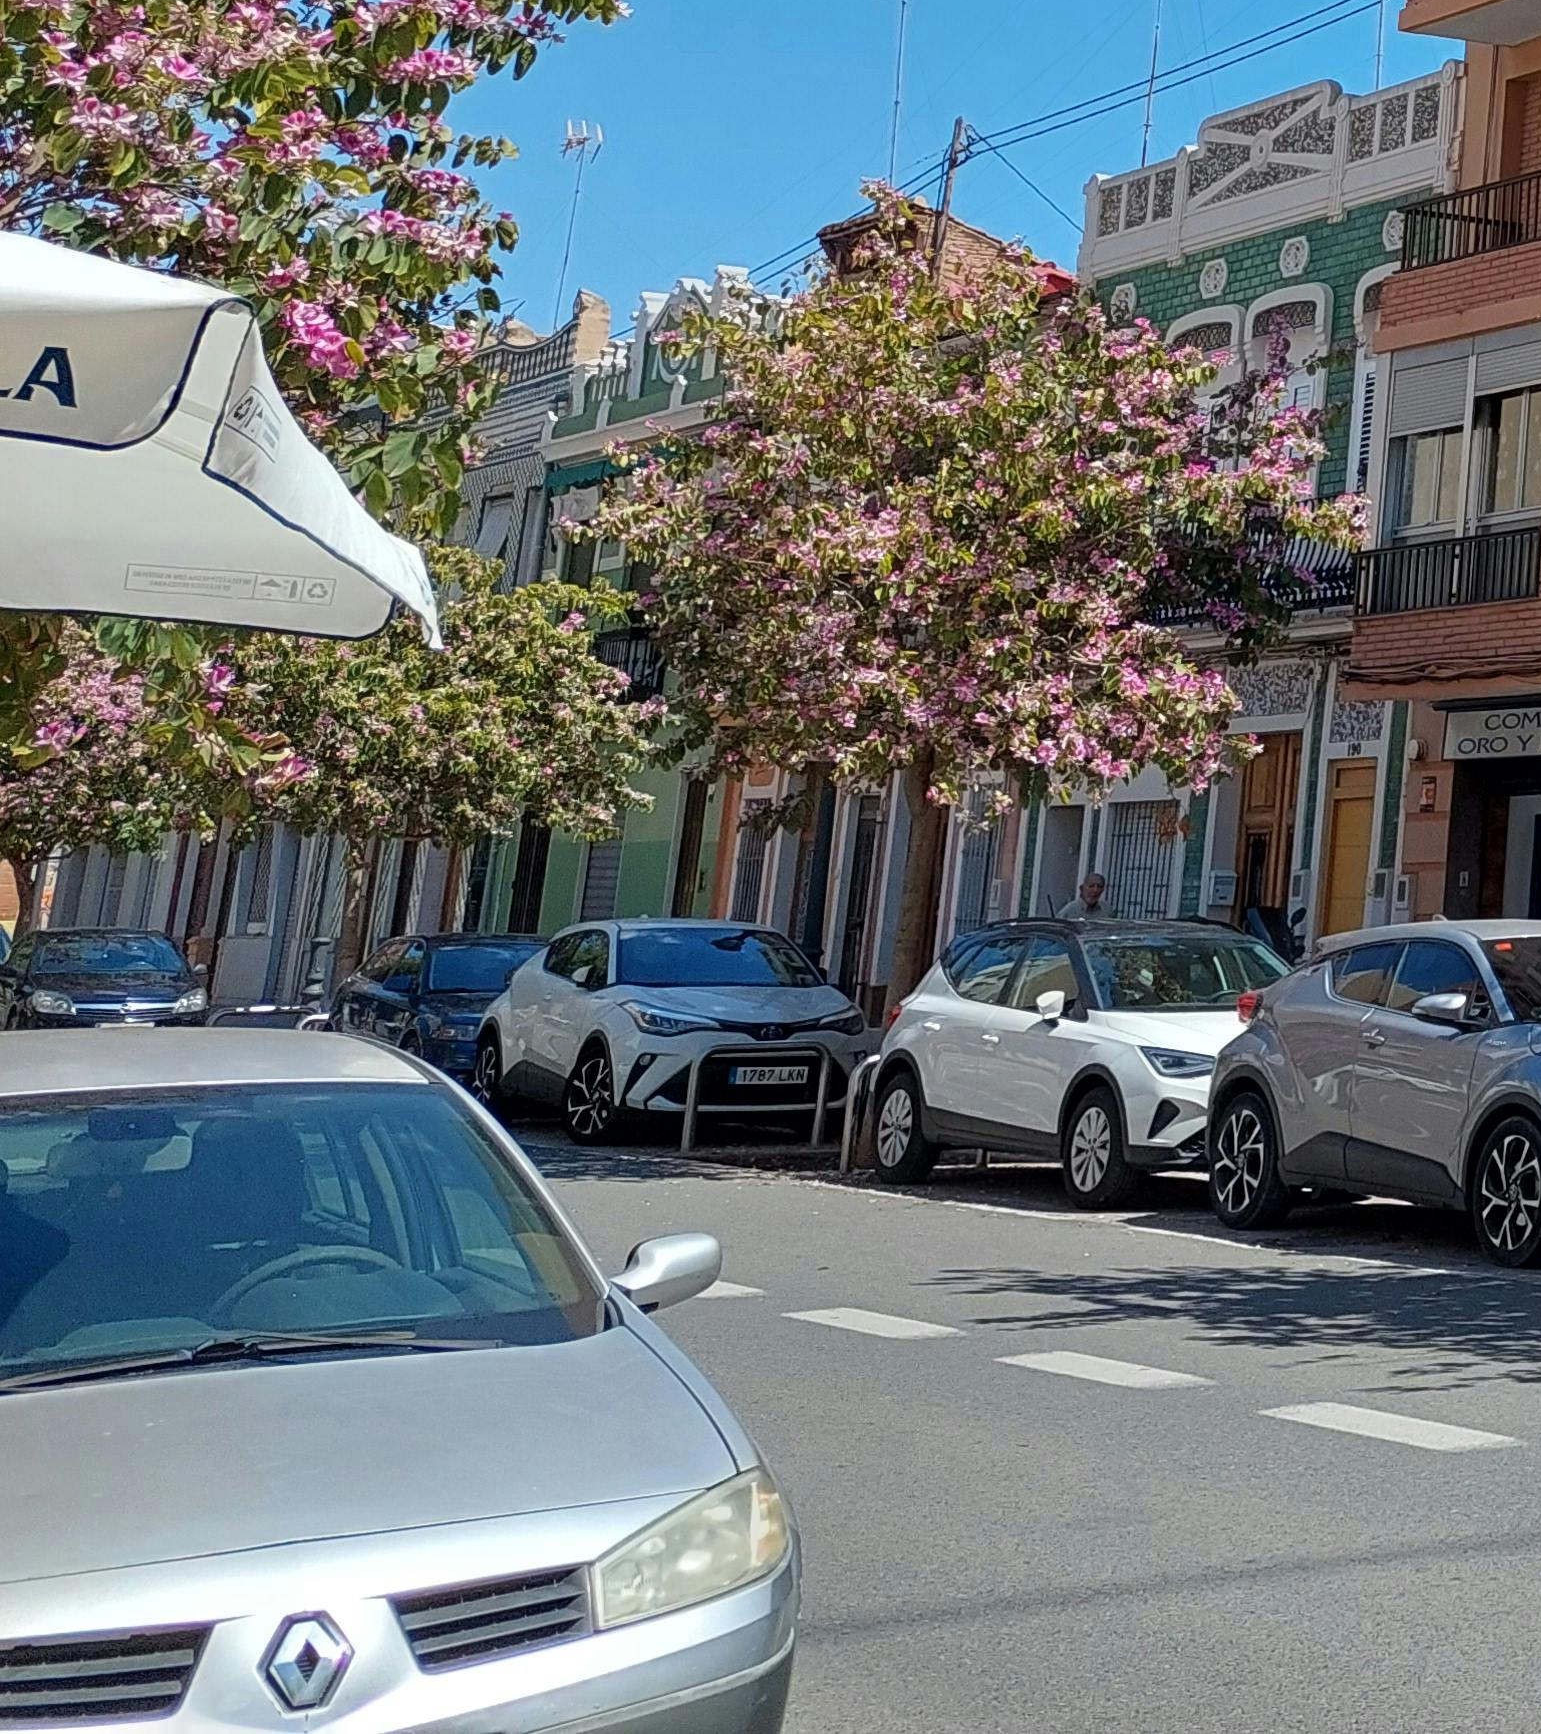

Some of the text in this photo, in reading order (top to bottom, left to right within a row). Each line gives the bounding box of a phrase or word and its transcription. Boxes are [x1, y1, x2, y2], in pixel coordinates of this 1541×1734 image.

[0, 346, 78, 408] A
[1457, 736, 1509, 755] ORO
[1516, 734, 1534, 752] Y
[742, 1068, 806, 1082] 1787 LKN
